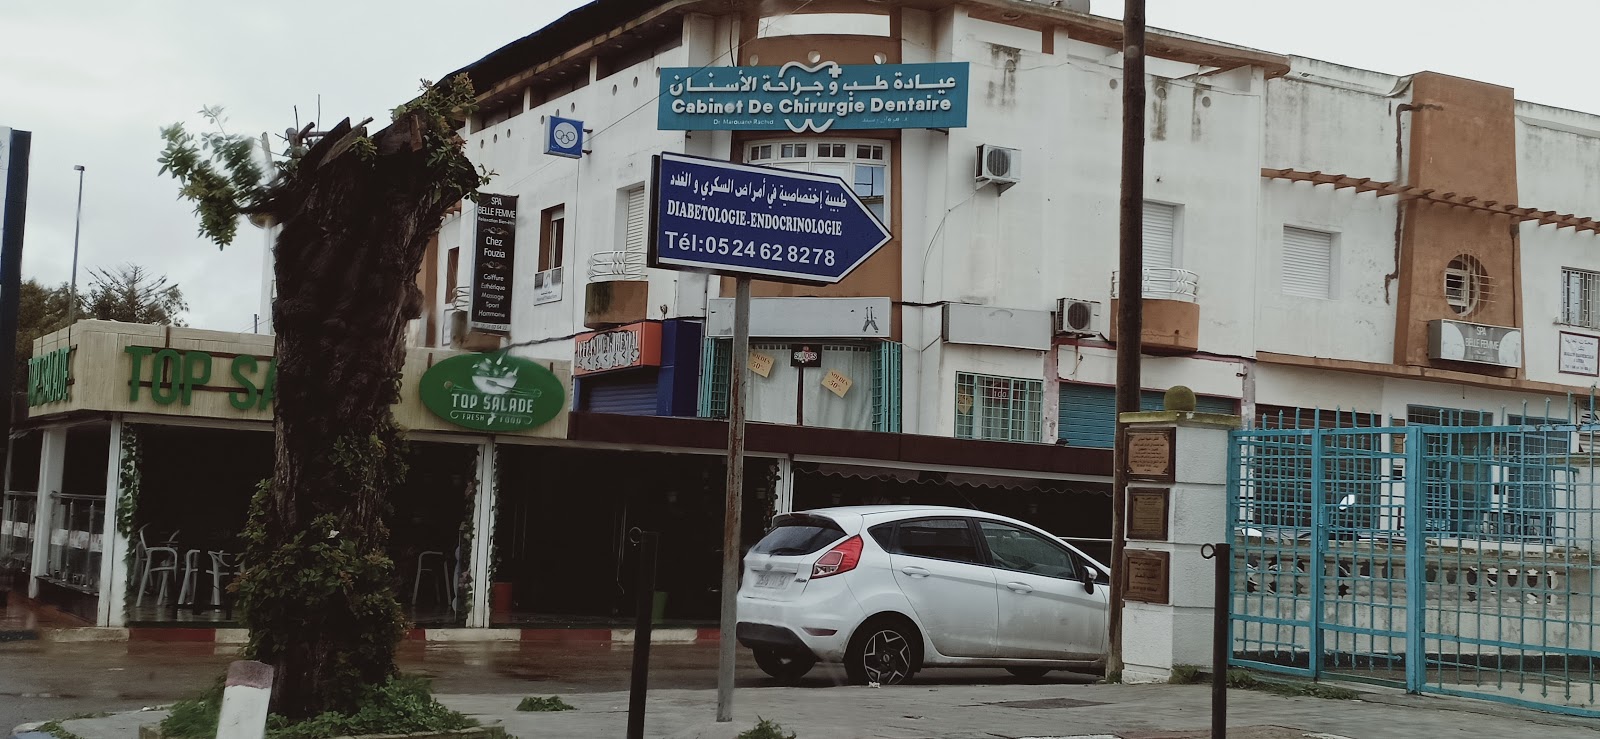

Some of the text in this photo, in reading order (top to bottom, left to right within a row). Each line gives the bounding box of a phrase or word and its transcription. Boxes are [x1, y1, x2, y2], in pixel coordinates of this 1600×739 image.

[670, 70, 757, 96] الأسنان
[763, 75, 824, 96] جراحة
[829, 81, 838, 95] و
[894, 72, 956, 94] عيادة
[672, 95, 951, 116] Cabinet De Chirurgie Dentaire
[670, 171, 691, 187] الغدد
[693, 179, 699, 194] و
[700, 175, 734, 201] السكري
[735, 178, 766, 203] أمراض
[490, 196, 503, 206] SPA
[767, 183, 777, 209] في
[825, 190, 847, 213] طبيبة
[495, 208, 516, 219] FEMME
[485, 236, 503, 247] Chez
[483, 248, 506, 259] Fouzia
[483, 273, 505, 282] Coiffure
[481, 292, 505, 301] Massage
[1476, 326, 1487, 336] SPA
[1465, 337, 1500, 351] BELLE FEMME
[125, 345, 212, 406] TOP
[831, 371, 848, 386] SOLDES
[451, 393, 534, 413] TOP SALADE
[462, 413, 485, 421] FRESH
